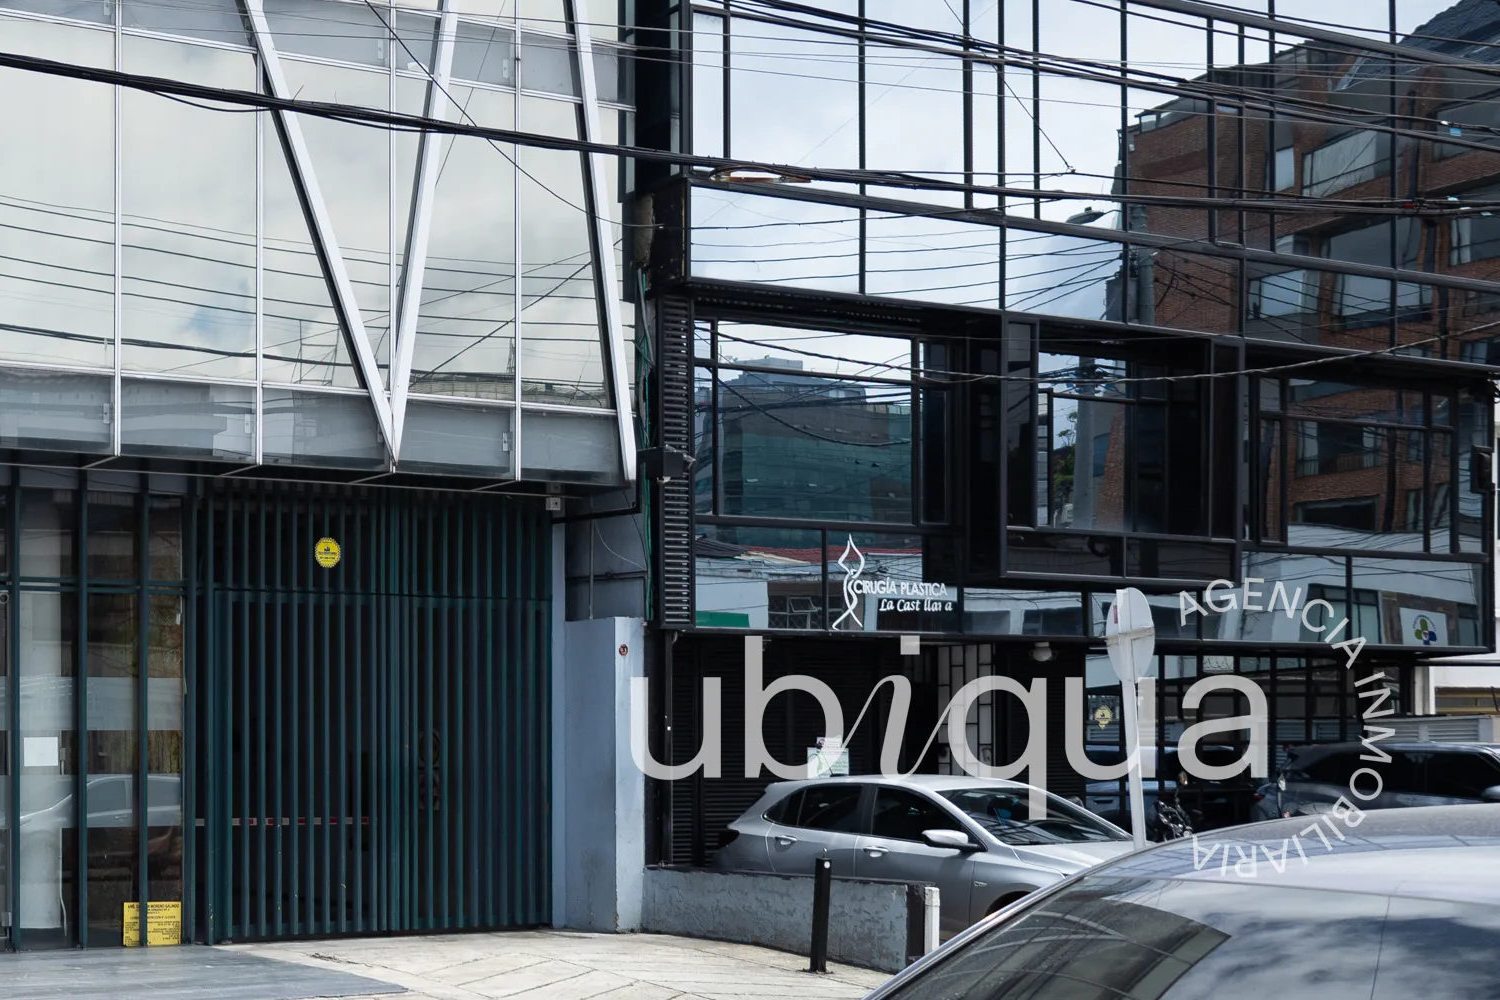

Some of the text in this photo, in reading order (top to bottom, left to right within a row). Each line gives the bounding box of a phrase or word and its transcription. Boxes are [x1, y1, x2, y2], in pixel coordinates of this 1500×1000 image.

[853, 577, 948, 596] CIRUGÍA PLASTICA
[879, 598, 894, 612] La
